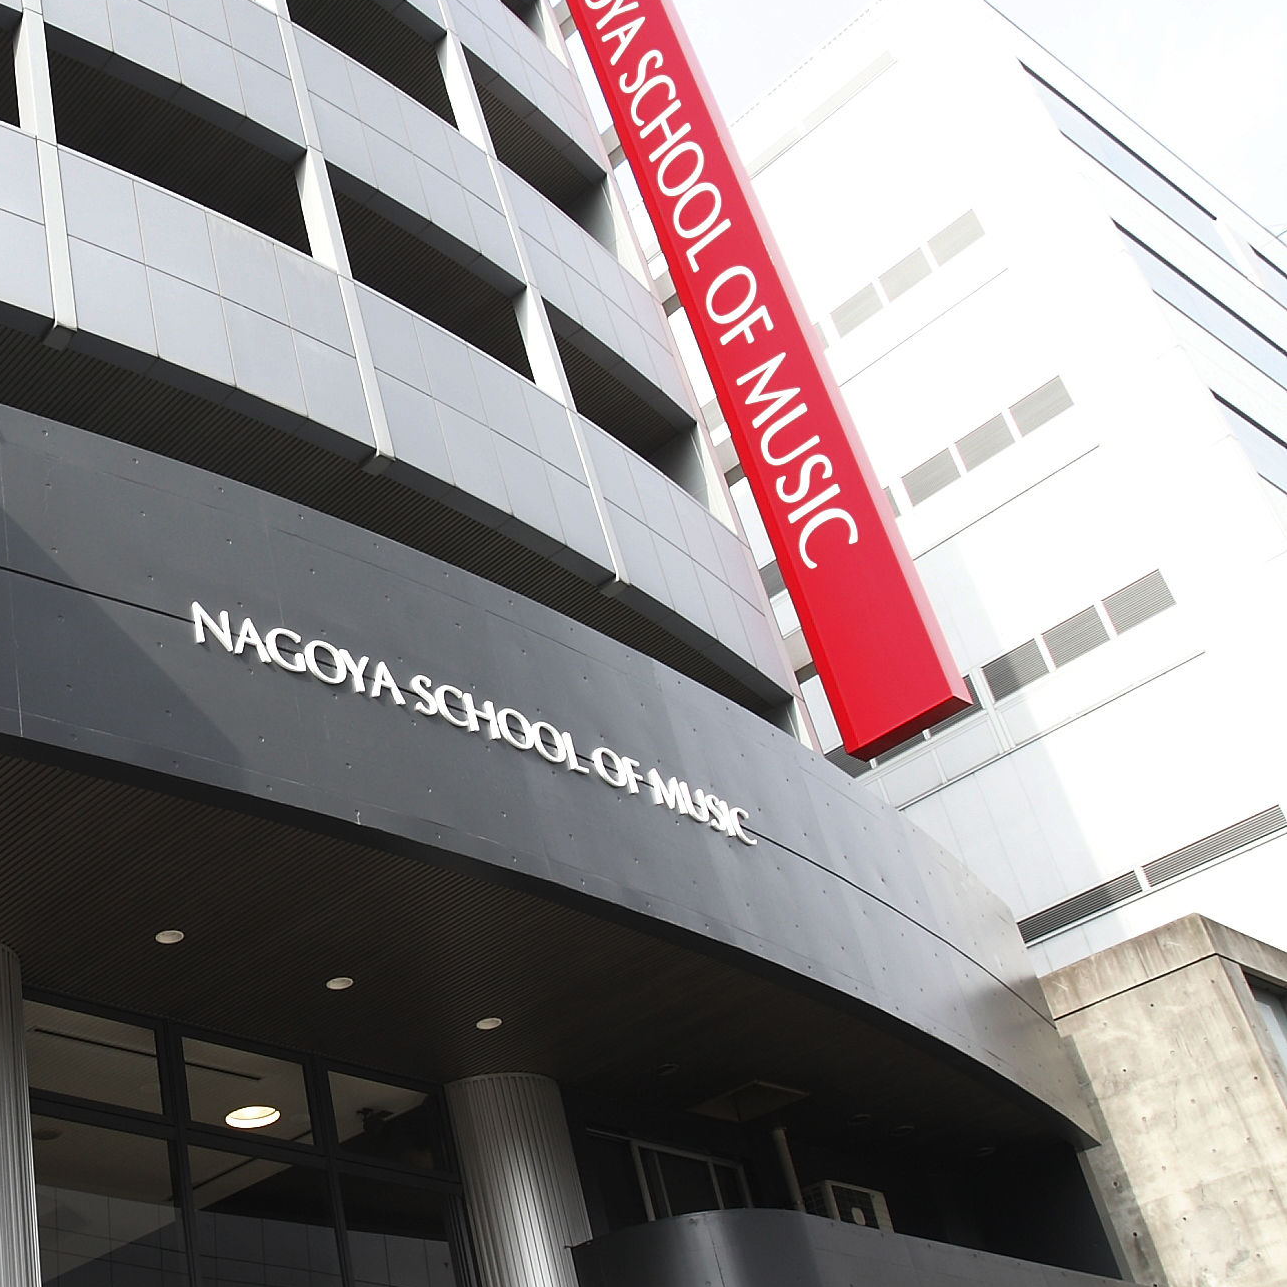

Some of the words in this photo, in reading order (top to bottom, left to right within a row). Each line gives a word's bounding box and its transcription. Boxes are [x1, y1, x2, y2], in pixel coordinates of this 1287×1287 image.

[618, 49, 732, 273] SCHOOL
[705, 265, 774, 346] OF
[736, 351, 859, 570] MUSIC
[191, 600, 407, 706] NAGOYA
[410, 674, 590, 775] SCHOOL
[592, 746, 644, 795] OF
[647, 767, 758, 846] MUSIC
